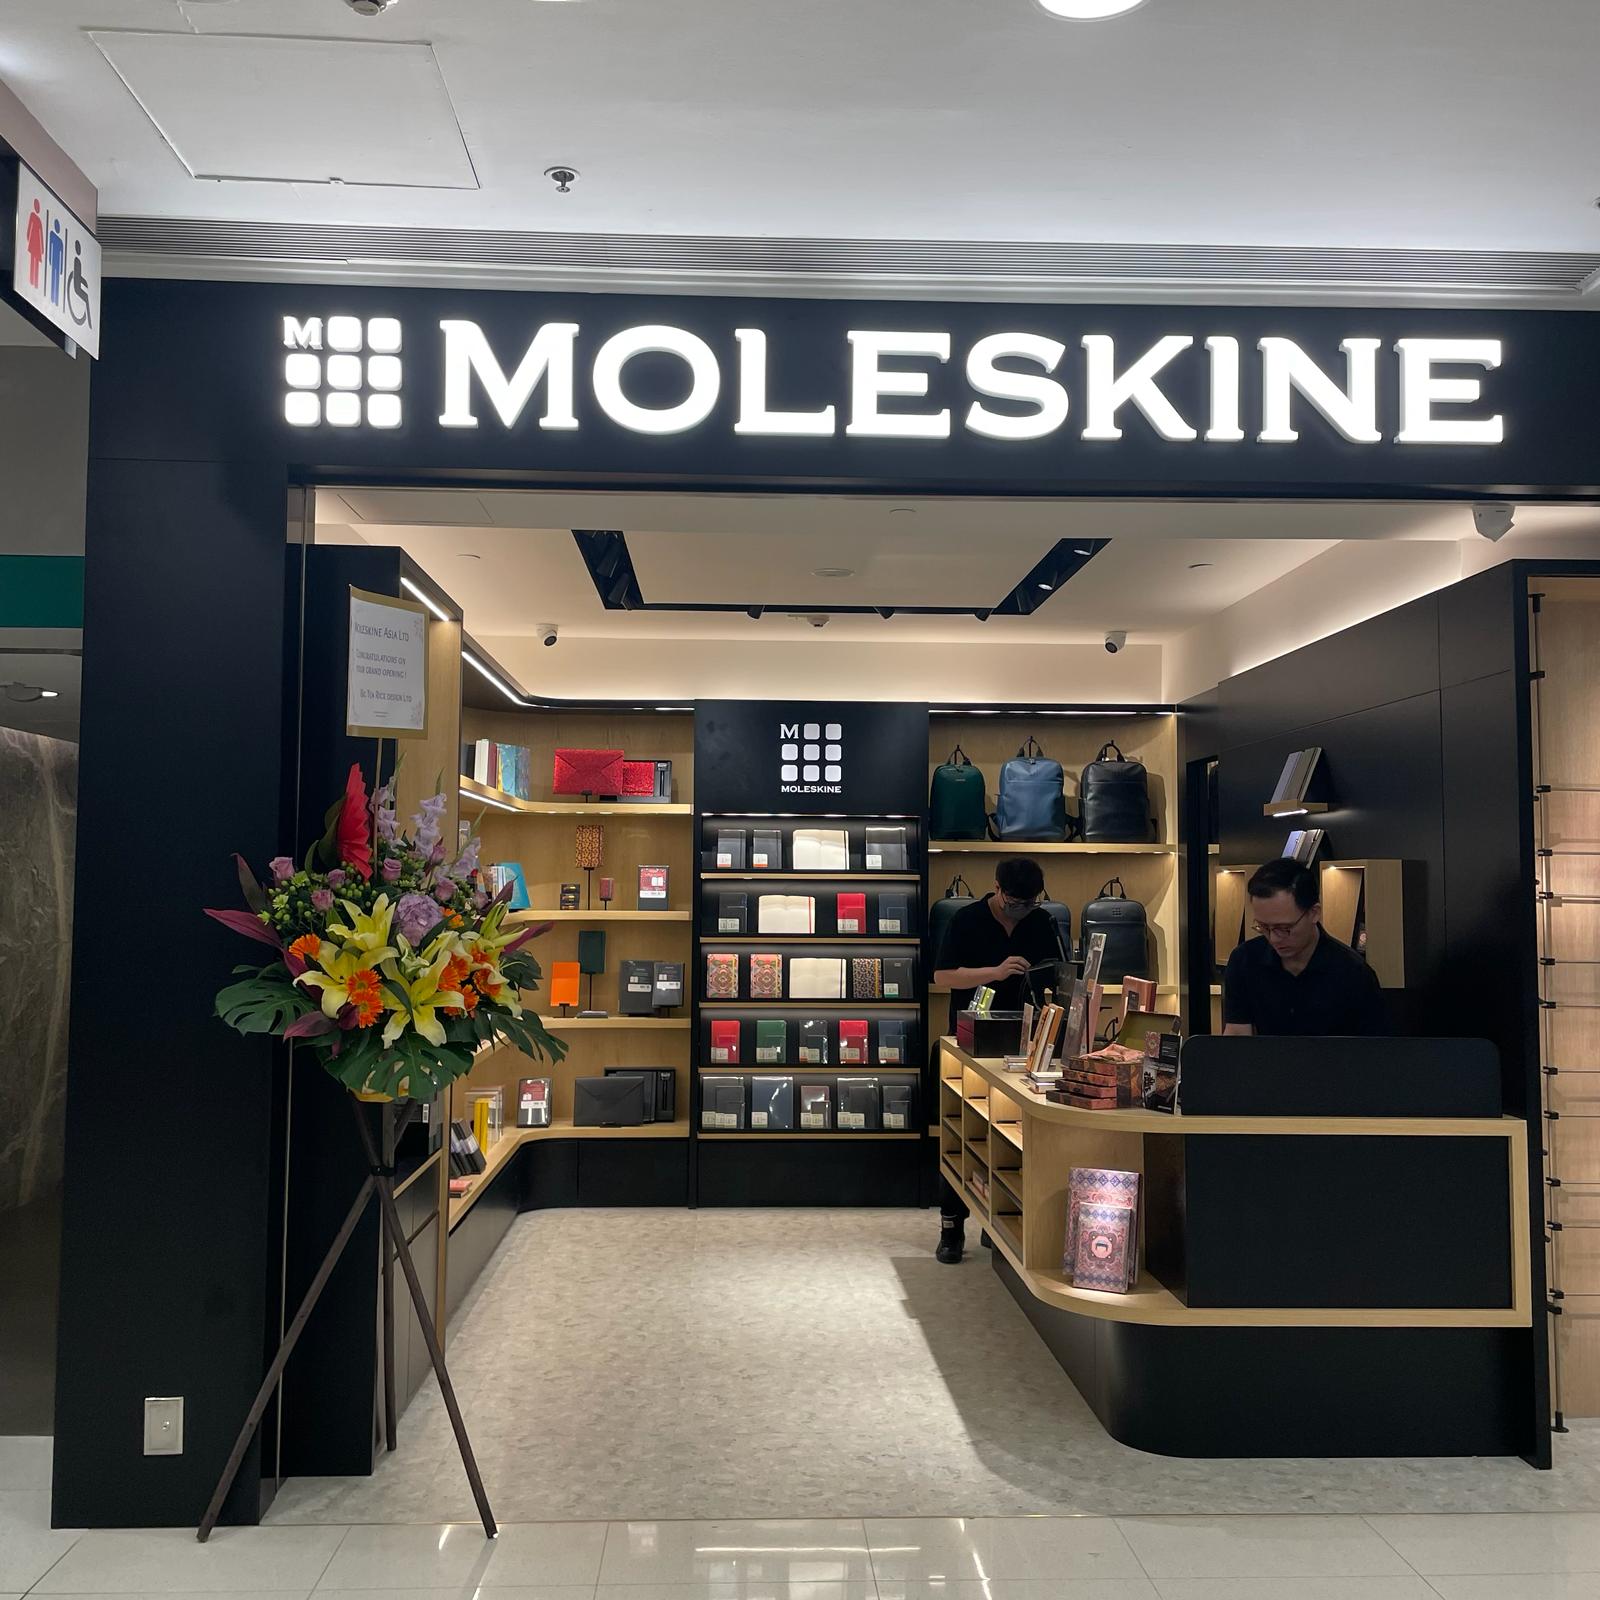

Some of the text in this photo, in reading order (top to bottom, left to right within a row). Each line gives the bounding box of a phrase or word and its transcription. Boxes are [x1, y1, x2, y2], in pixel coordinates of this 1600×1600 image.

[283, 316, 323, 350] M
[438, 319, 1504, 446] MOLESKINE
[780, 723, 799, 739] M
[781, 785, 842, 793] MOLESKINE
